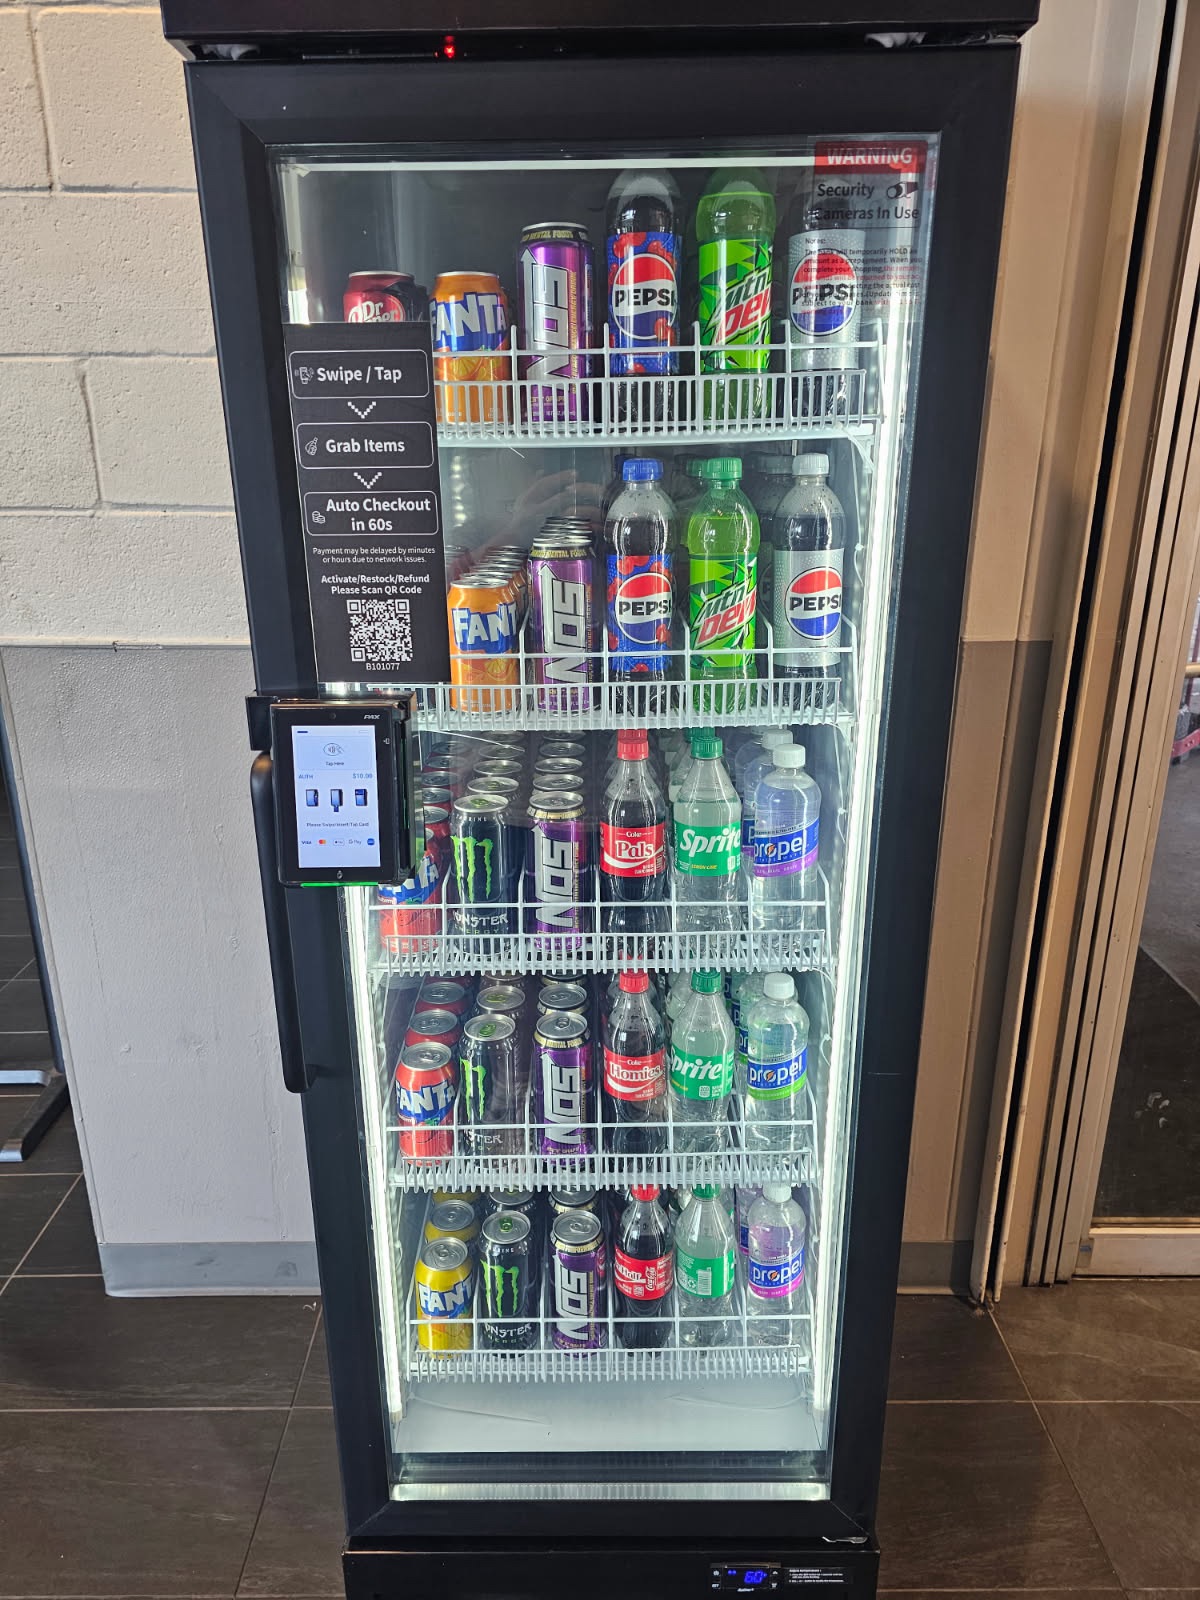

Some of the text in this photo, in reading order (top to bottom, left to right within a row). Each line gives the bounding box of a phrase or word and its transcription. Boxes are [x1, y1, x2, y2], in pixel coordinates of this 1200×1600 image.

[828, 147, 912, 164] WARNING
[817, 182, 874, 199] Security
[815, 206, 920, 220] Cameras In Use
[362, 301, 384, 320] Dr
[316, 366, 402, 385] Swipe / Tap
[326, 438, 405, 453] Grab Items
[326, 497, 431, 512] Auto Checkout
[351, 517, 393, 531] in 60s
[312, 547, 343, 556] Payment
[344, 548, 359, 556] may
[370, 547, 397, 556] delayed
[398, 547, 407, 556] by
[407, 546, 436, 554] minutes
[375, 555, 403, 563] network
[321, 574, 430, 585] Activate/Restock/Refund
[331, 585, 422, 596] Please Scan QR Code
[366, 662, 400, 671] B101077
[615, 840, 654, 859] Pals
[610, 1061, 661, 1081] Homies
[749, 1055, 803, 1086] propel
[753, 1253, 802, 1284] propel
